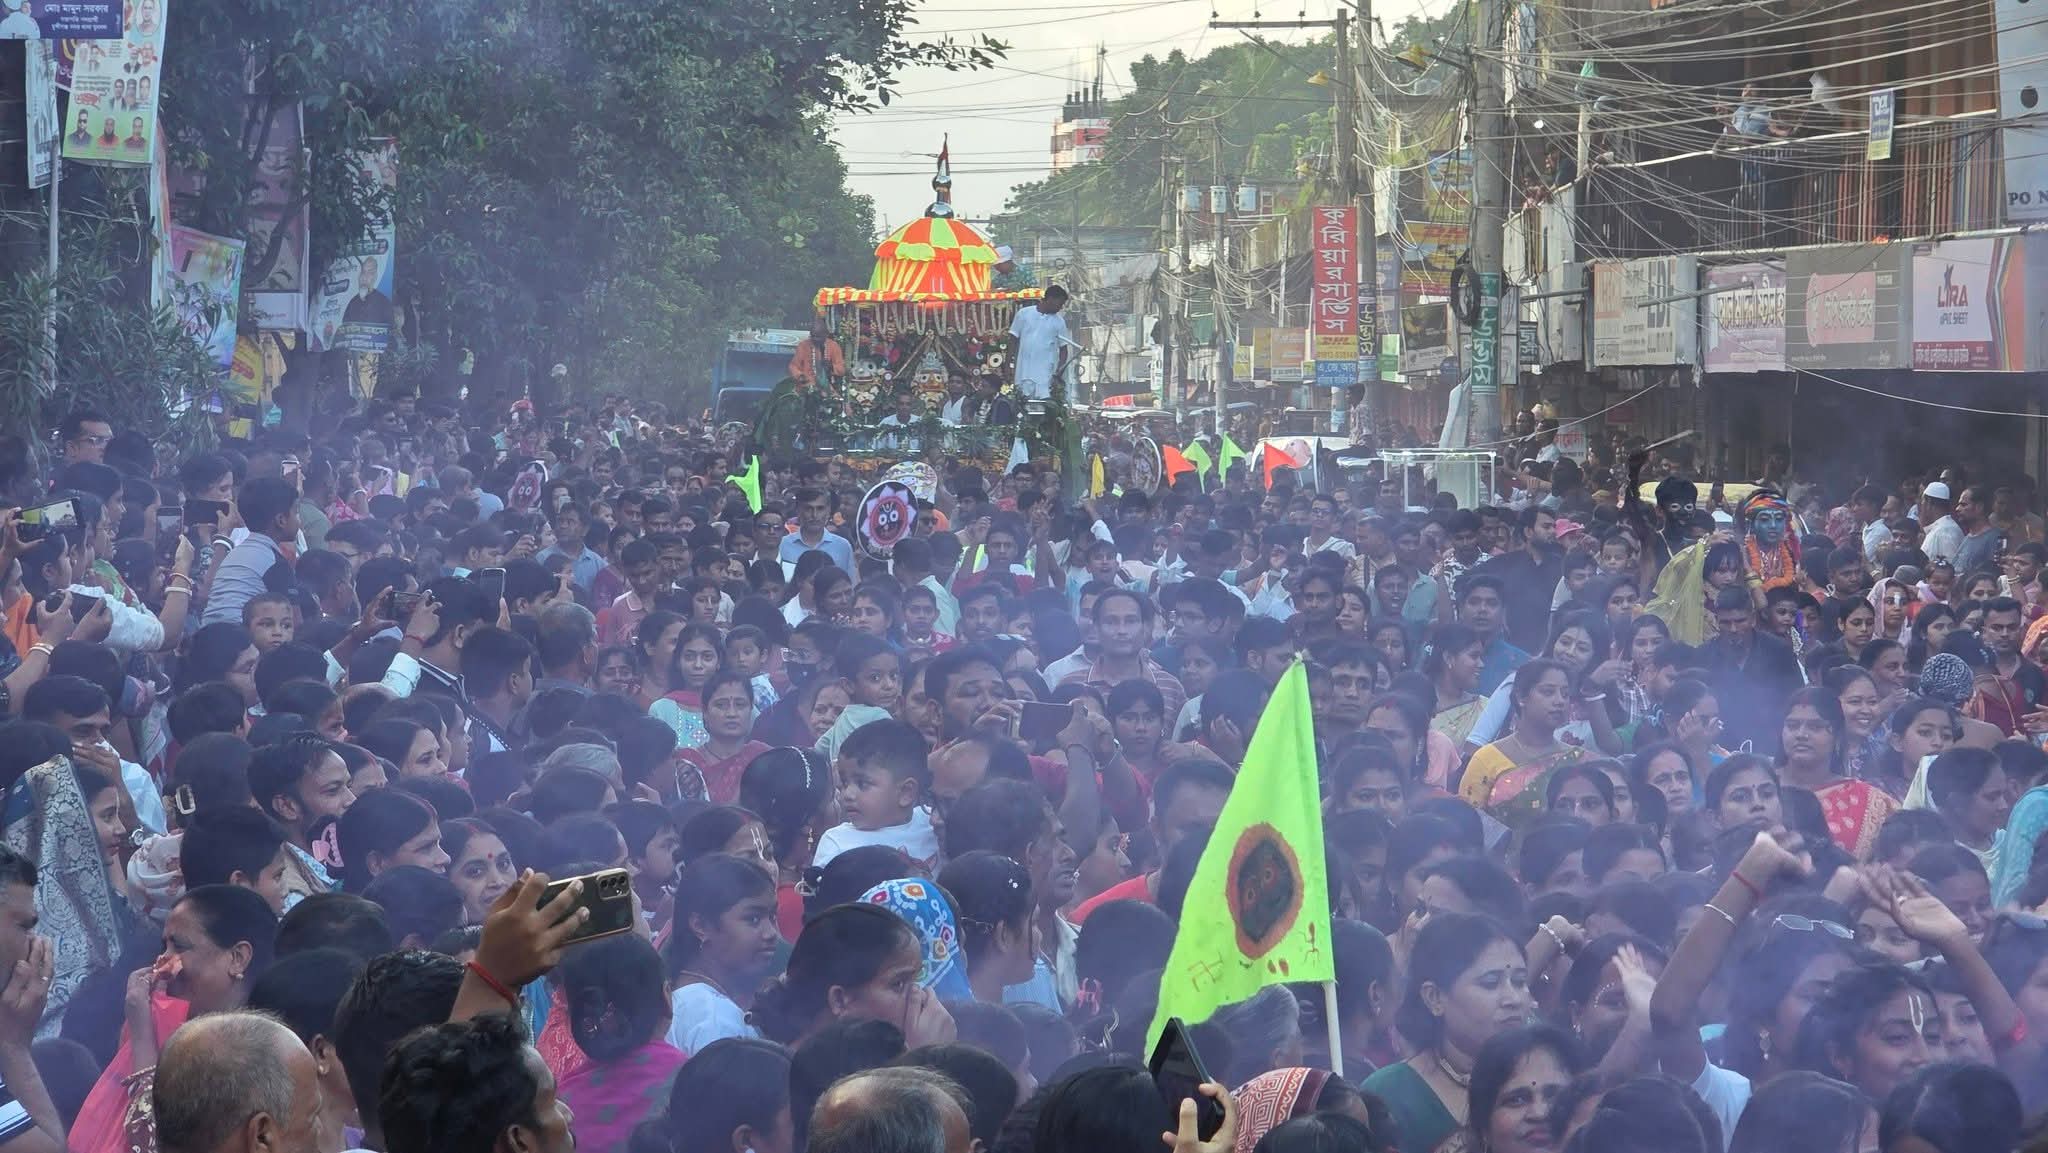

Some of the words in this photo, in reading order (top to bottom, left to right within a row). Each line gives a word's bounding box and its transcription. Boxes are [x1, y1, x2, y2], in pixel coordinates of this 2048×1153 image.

[1319, 207, 1352, 280] কুরিয়ার
[1317, 281, 1353, 334] সার্ভিস
[1937, 284, 1969, 308] LIRA
